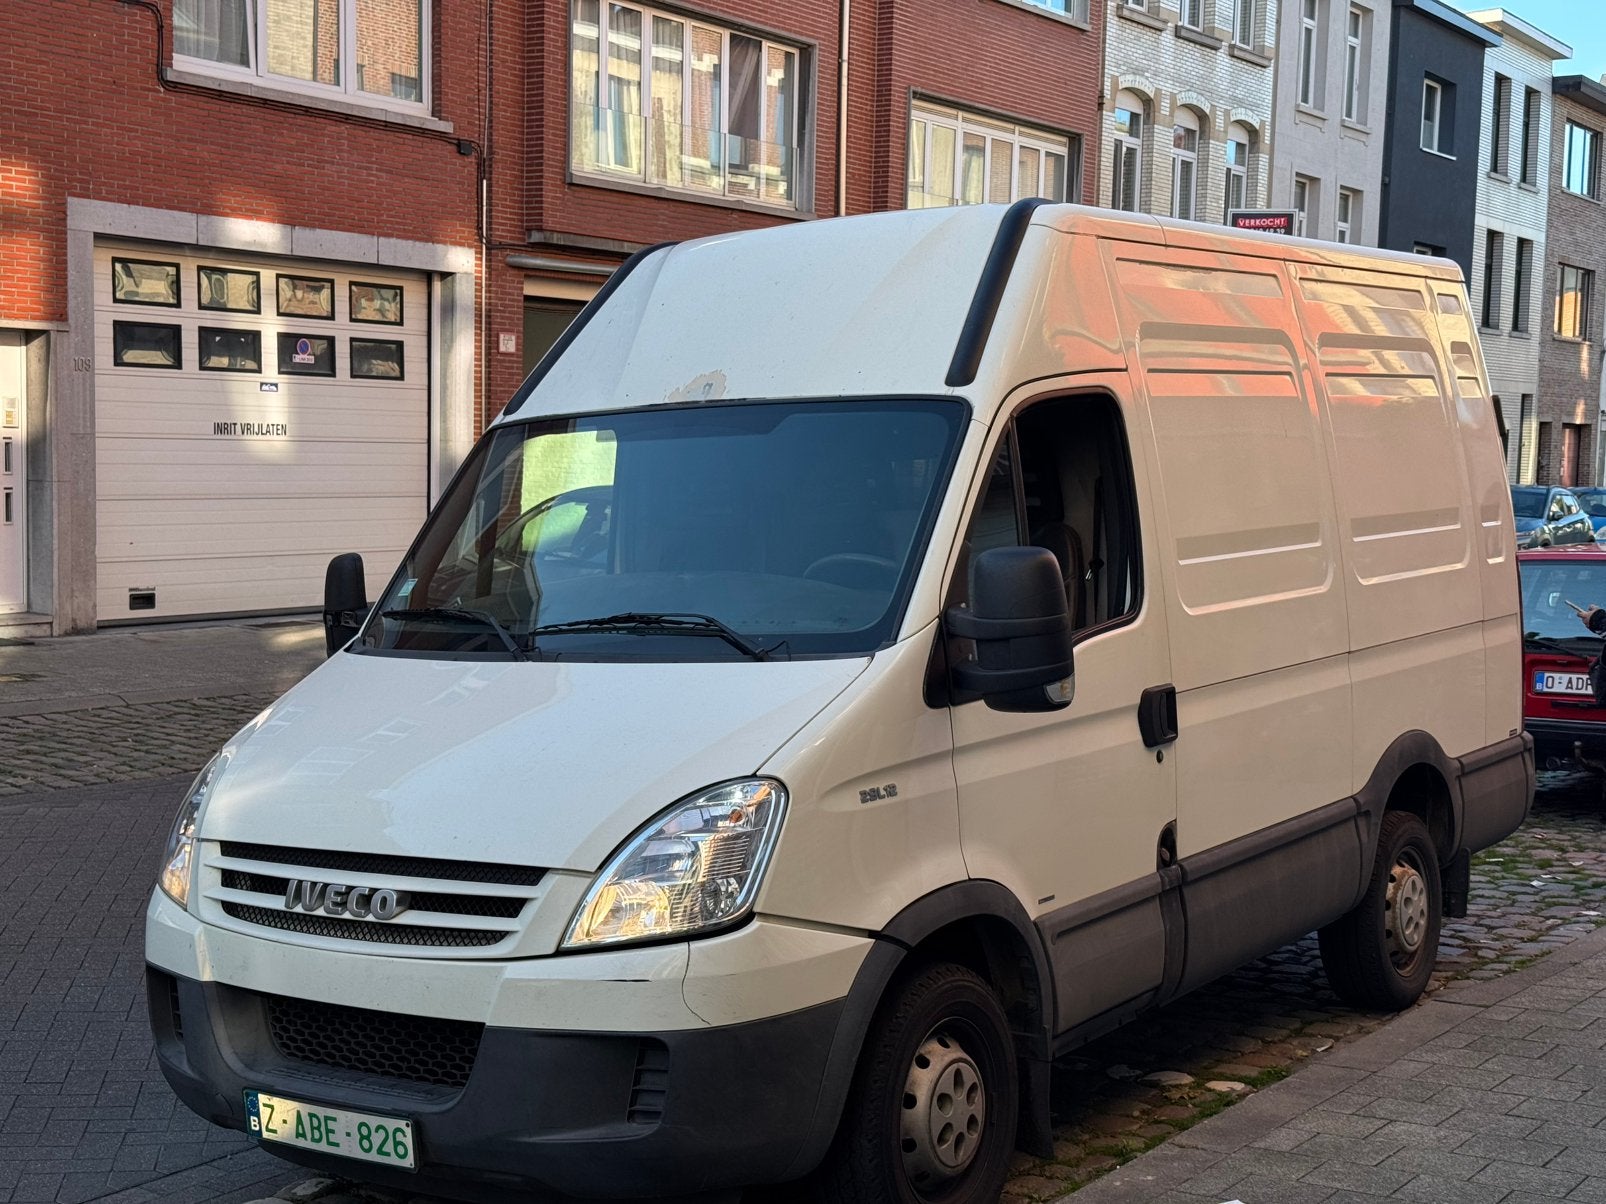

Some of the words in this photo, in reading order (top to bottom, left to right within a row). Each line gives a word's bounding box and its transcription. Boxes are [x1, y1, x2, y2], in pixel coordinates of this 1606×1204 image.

[1238, 217, 1286, 227] VERKOCHT
[213, 422, 238, 436] INRIT
[239, 422, 287, 436] VRIJLATEN
[284, 879, 404, 921] IVECO
[250, 1115, 260, 1131] B
